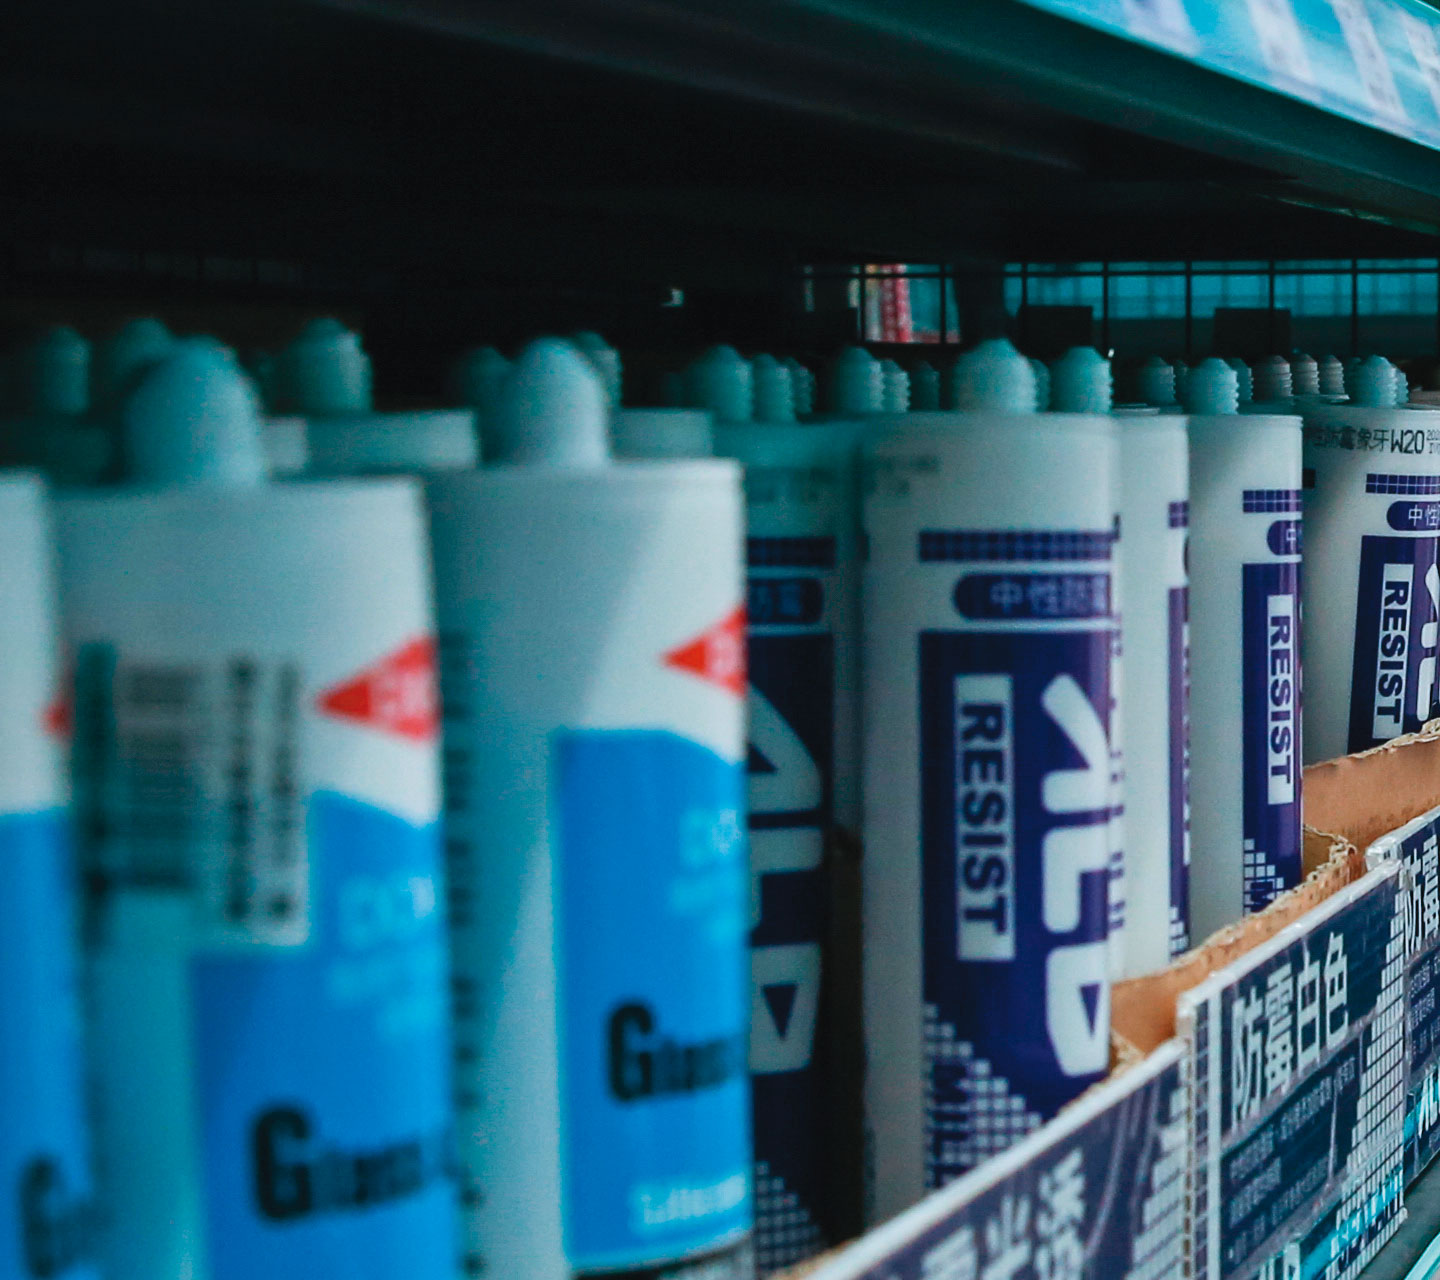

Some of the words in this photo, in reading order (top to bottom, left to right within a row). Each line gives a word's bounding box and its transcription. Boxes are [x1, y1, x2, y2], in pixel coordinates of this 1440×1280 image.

[1269, 614, 1292, 785] RESIST
[1375, 580, 1410, 724] RESIST
[963, 701, 1007, 936] RESIST
[1231, 931, 1349, 1134] 防霉白色
